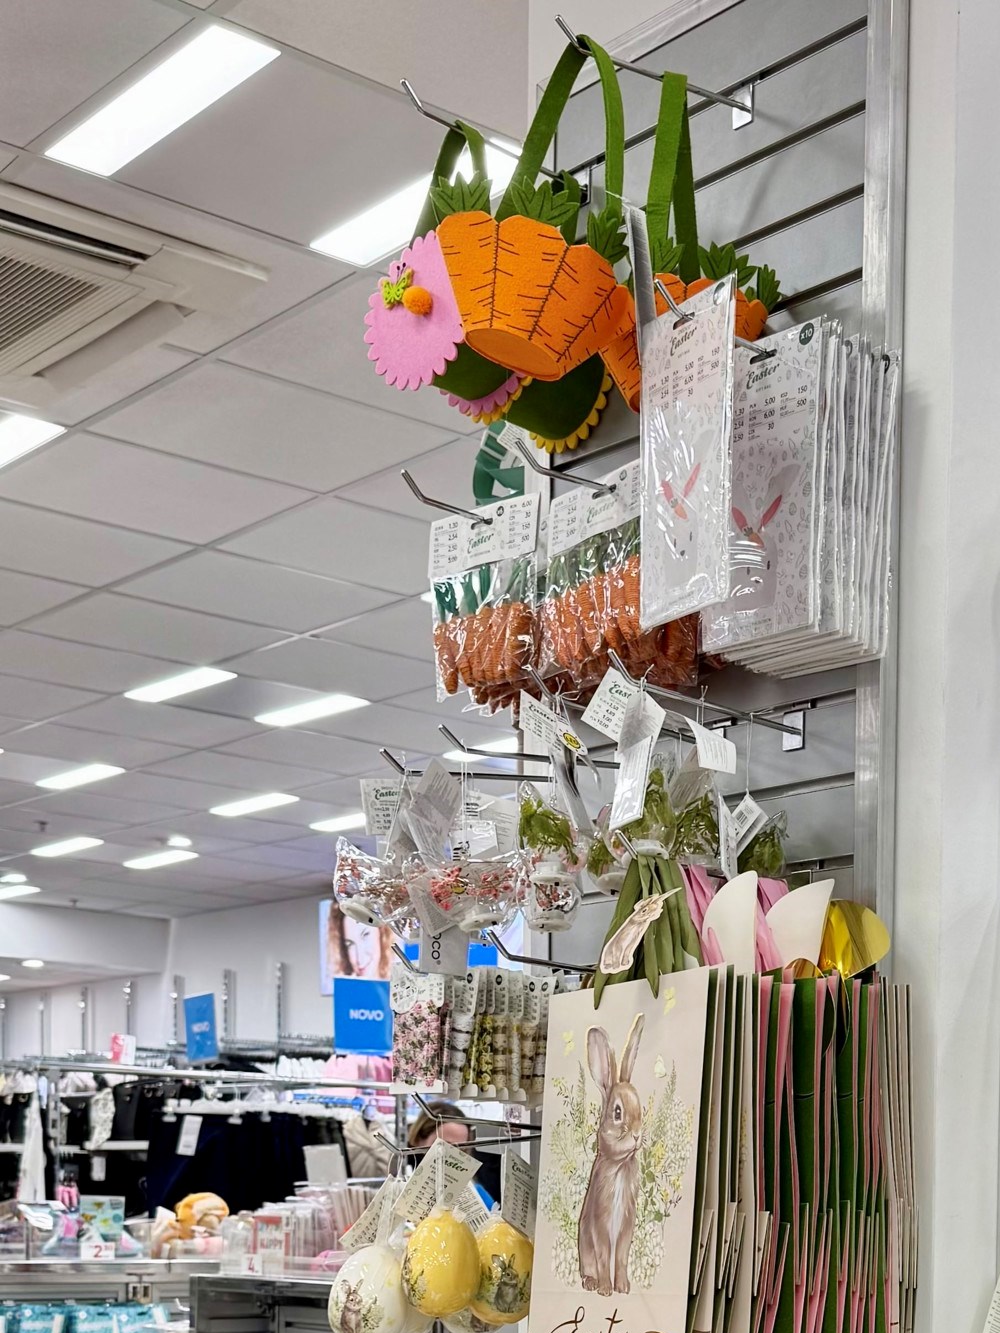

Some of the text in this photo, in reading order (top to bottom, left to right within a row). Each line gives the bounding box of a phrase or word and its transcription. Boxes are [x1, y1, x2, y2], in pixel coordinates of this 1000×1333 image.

[801, 328, 813, 339] x10
[669, 327, 697, 357] Easter
[684, 361, 694, 372] 5,00
[746, 363, 780, 389] Easter
[798, 385, 807, 394] 150
[764, 397, 776, 407] 5,00
[797, 398, 807, 408] 500
[763, 410, 775, 419] 6,00
[767, 423, 774, 431] 30
[586, 498, 618, 524] Easter
[466, 533, 495, 554] Easter
[609, 681, 632, 698] East
[528, 701, 556, 722] Easter
[349, 1008, 385, 1022] NOVO
[511, 1159, 534, 1180] Easter
